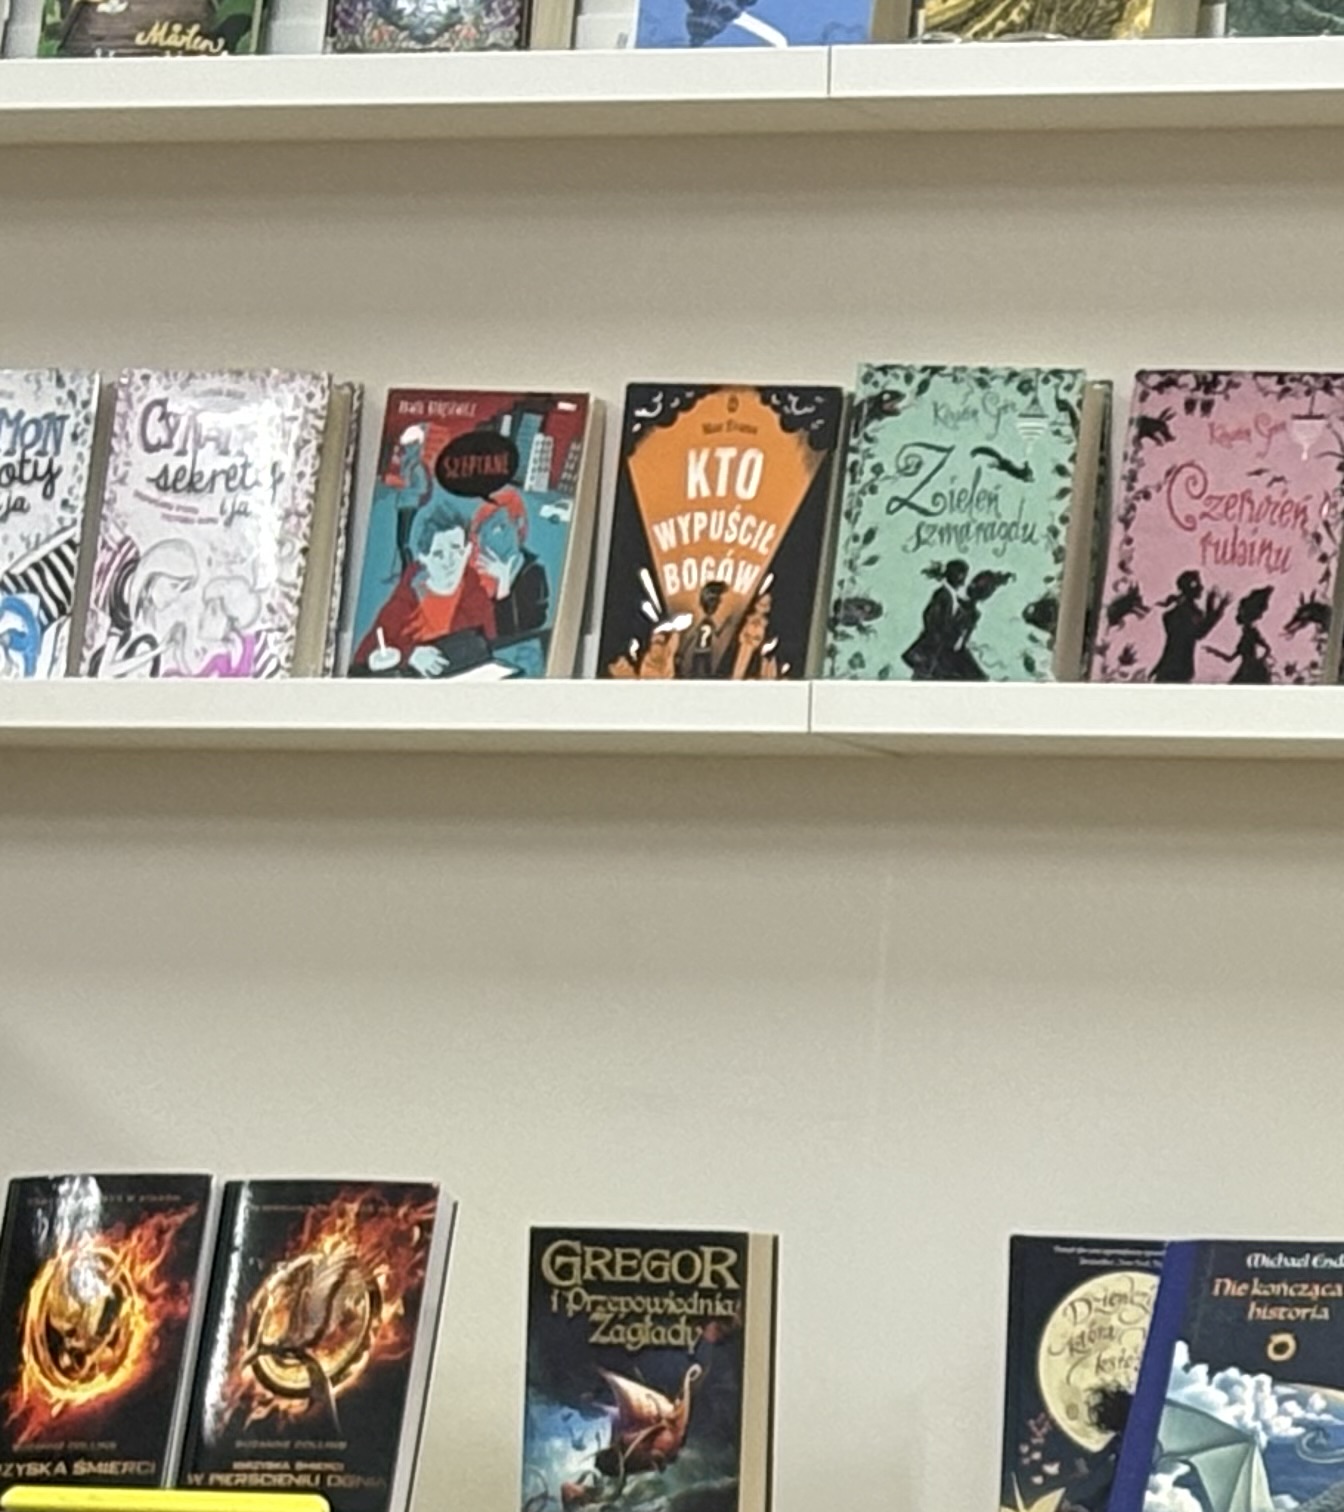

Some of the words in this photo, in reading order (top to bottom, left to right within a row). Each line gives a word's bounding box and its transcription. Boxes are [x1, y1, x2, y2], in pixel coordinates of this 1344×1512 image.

[686, 446, 763, 500] KTO
[884, 441, 1002, 519] Zieleń
[1166, 461, 1311, 533] Czerwień
[652, 503, 776, 557] WYPUŚCIŁ
[1200, 526, 1293, 576] rubinu
[662, 549, 761, 597] BOGÓW
[541, 1239, 742, 1291] GREGOR
[1246, 1252, 1309, 1271] Michael
[565, 1286, 739, 1319] Przepowiednia
[1211, 1277, 1250, 1299] Nie
[1251, 1277, 1344, 1301] kończąca
[1246, 1299, 1332, 1322] historia
[588, 1311, 705, 1355] Zagłady
